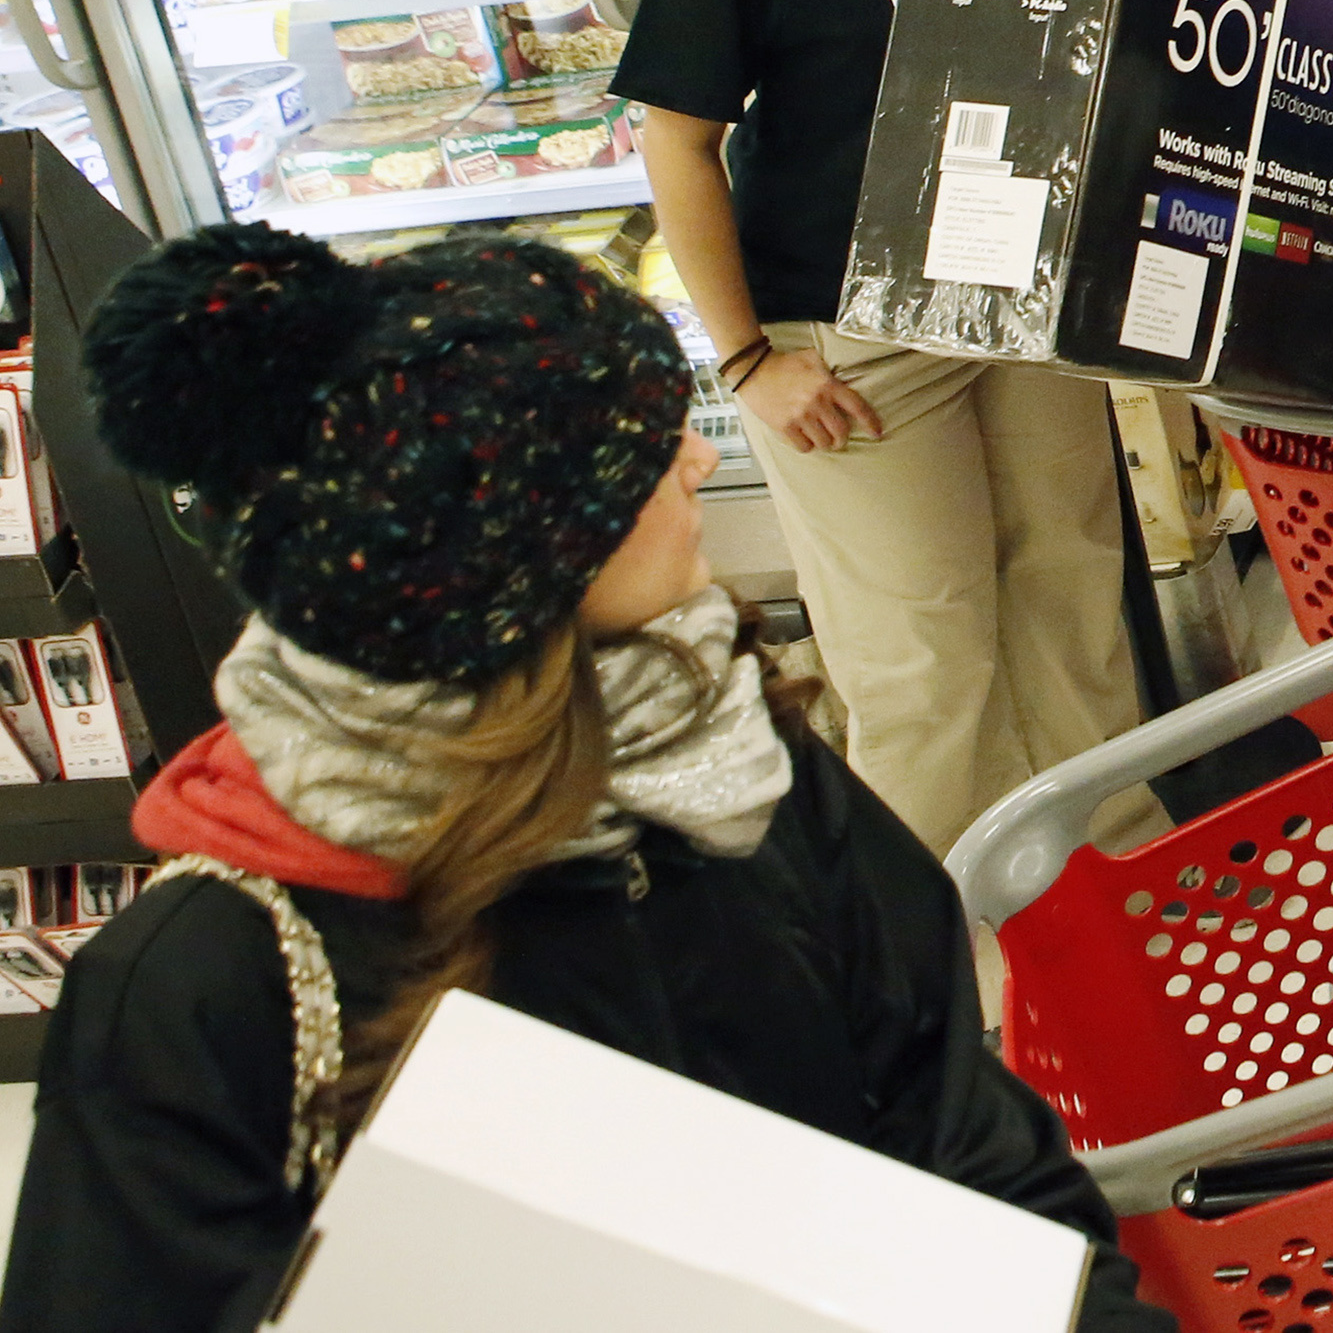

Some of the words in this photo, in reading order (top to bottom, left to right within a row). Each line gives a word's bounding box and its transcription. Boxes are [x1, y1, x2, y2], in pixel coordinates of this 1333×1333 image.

[1276, 37, 1333, 96] CLASS
[1153, 154, 1192, 177] Requires
[1191, 165, 1240, 189] high-speed
[1271, 189, 1288, 203] and
[1159, 127, 1201, 158] Works
[1203, 144, 1232, 167] with
[1266, 160, 1327, 197] Streaming
